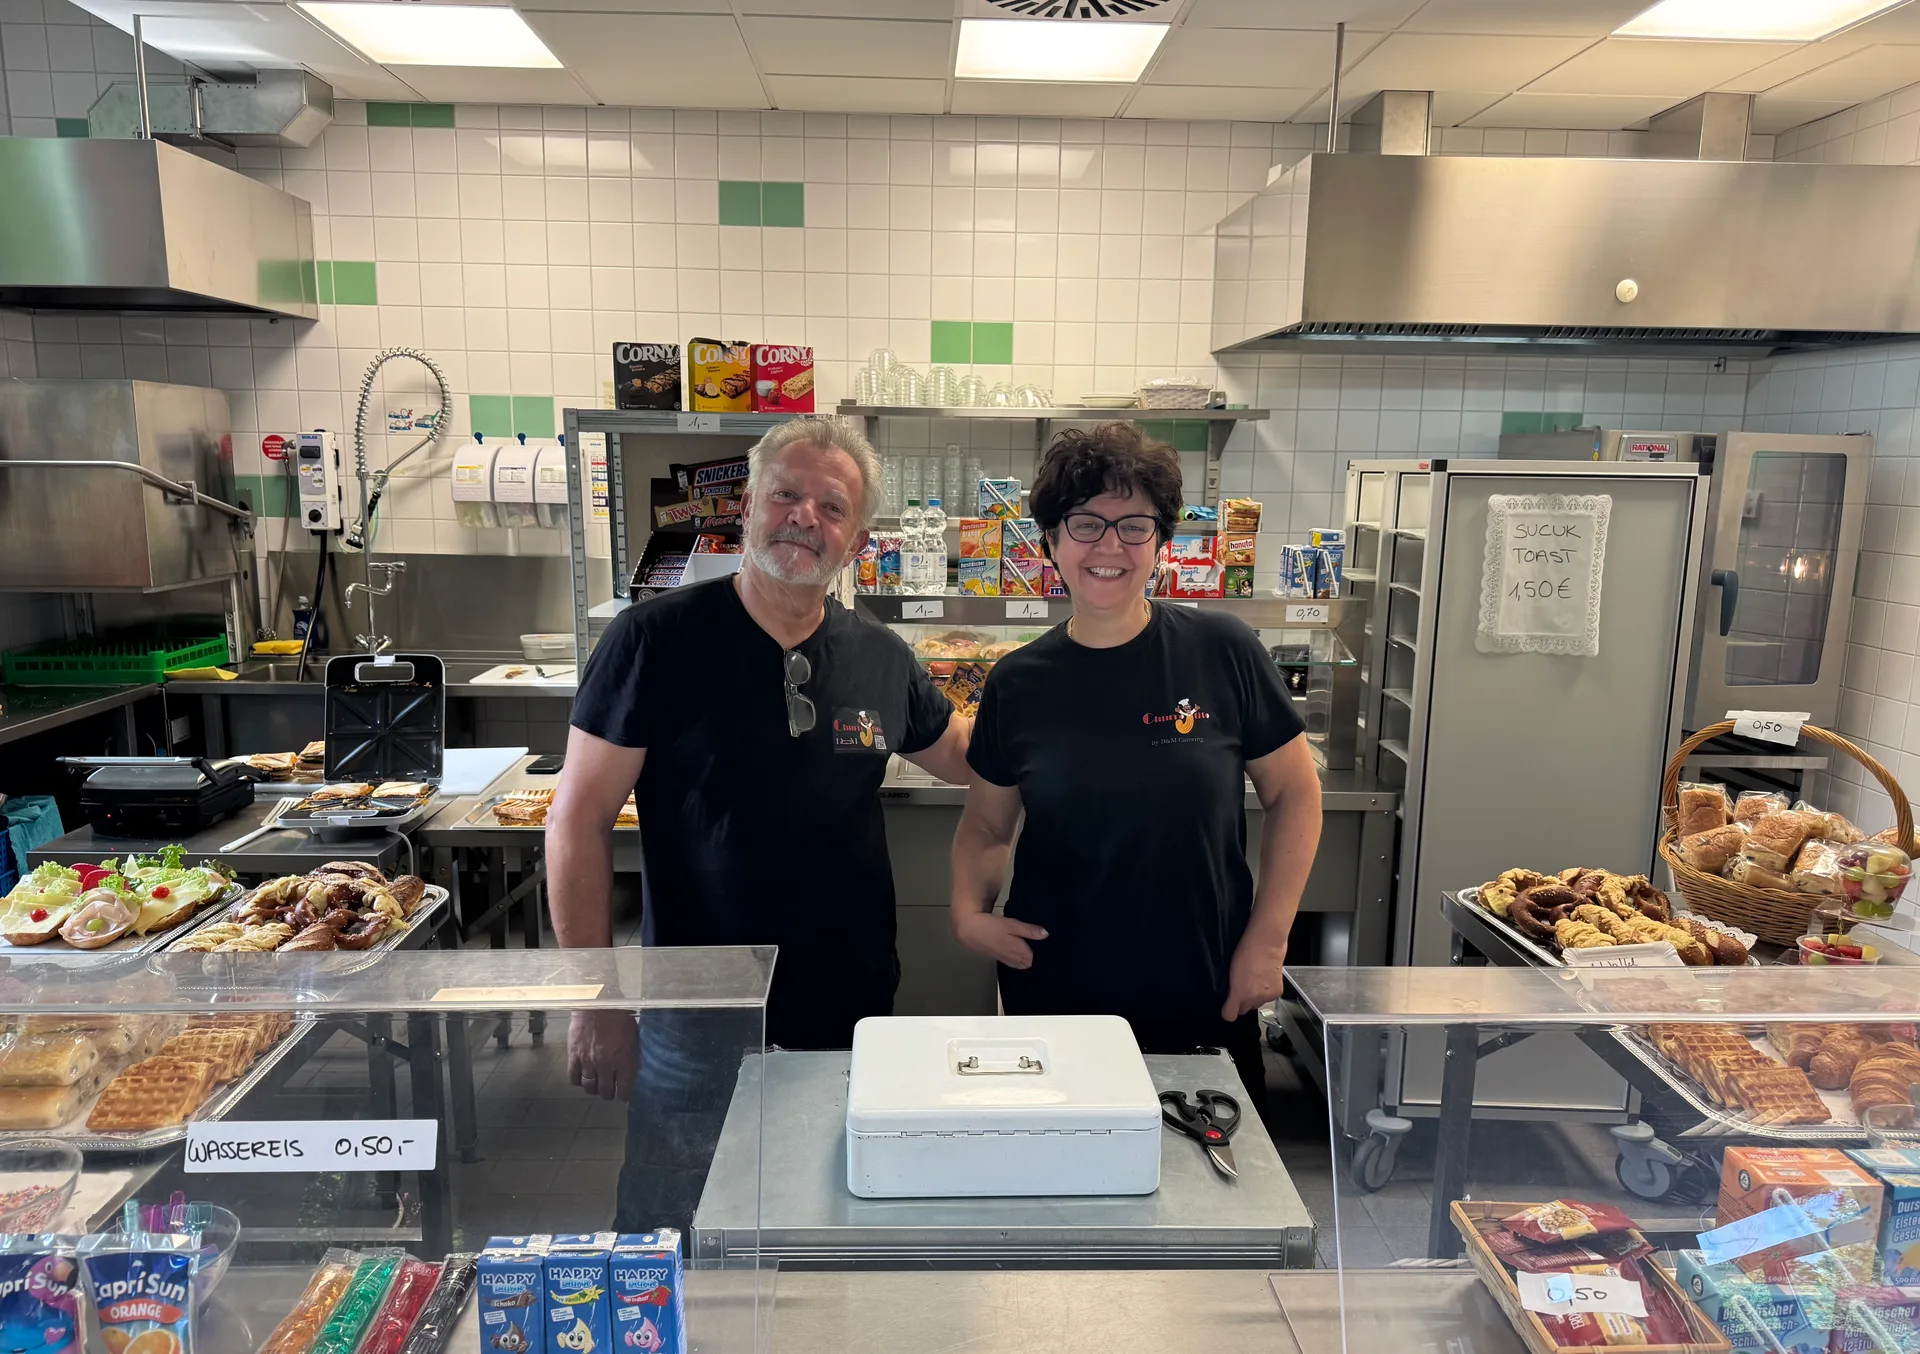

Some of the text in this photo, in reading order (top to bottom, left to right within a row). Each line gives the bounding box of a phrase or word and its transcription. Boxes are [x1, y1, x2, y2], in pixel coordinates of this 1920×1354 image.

[616, 344, 675, 364] CORNY
[756, 346, 808, 366] CORNY
[1631, 444, 1669, 452] RATIONAL
[696, 462, 750, 485] SNICKERS
[705, 485, 731, 495] SNICKERS
[667, 502, 704, 522] Twix
[702, 515, 737, 529] Mars
[1513, 523, 1582, 539] SUCUK
[1230, 541, 1253, 550] hanuta
[1512, 547, 1578, 564] TOAST
[1508, 577, 1573, 602] 1,50€
[1296, 607, 1320, 620] 0,70
[1752, 720, 1783, 734] 0,50
[187, 1136, 304, 1163] WASSEREIS
[481, 1273, 536, 1285] HAPPY
[549, 1267, 603, 1280] HAPPY
[615, 1269, 669, 1281] HAPPY
[1546, 1287, 1608, 1306] 0,50
[110, 1303, 162, 1320] ORANGE
[1722, 1303, 1794, 1320] Duöscher
